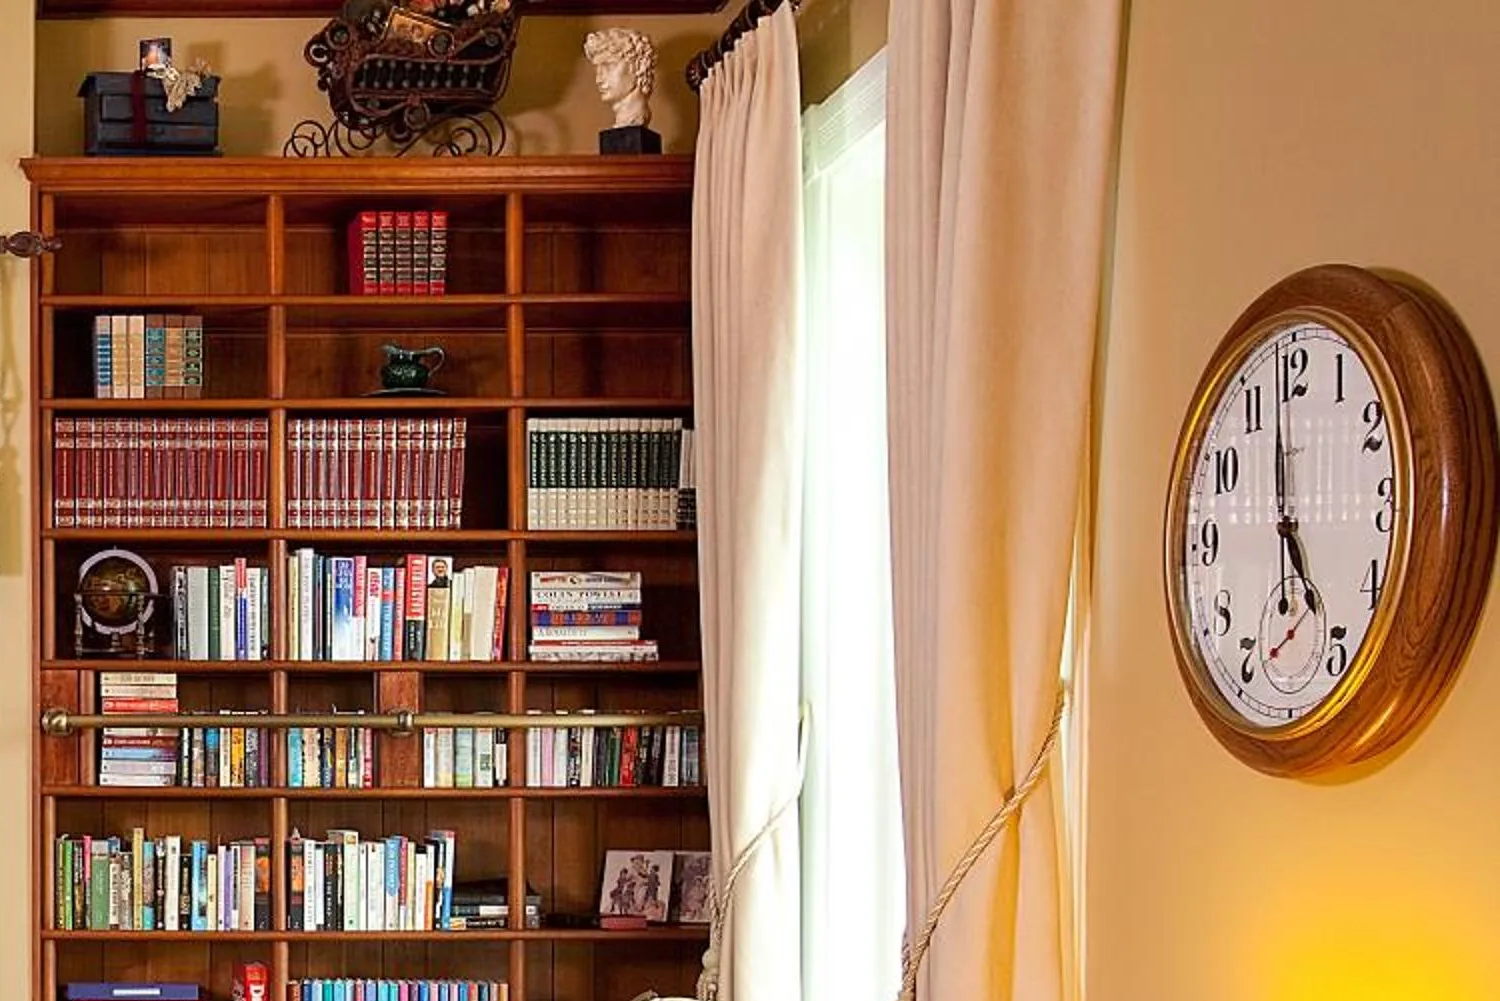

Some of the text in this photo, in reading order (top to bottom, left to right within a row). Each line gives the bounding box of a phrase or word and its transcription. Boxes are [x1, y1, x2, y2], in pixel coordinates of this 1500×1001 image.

[1281, 348, 1309, 404] 12
[1333, 354, 1345, 404] 1
[1244, 385, 1264, 435] 11
[1362, 400, 1384, 453] 2
[1214, 446, 1240, 495] 10
[1376, 477, 1394, 533] 3
[1201, 521, 1220, 567] 9
[1359, 559, 1381, 611] 4
[1213, 589, 1233, 637] 8
[1239, 637, 1257, 683] 7
[1326, 625, 1347, 677] 5
